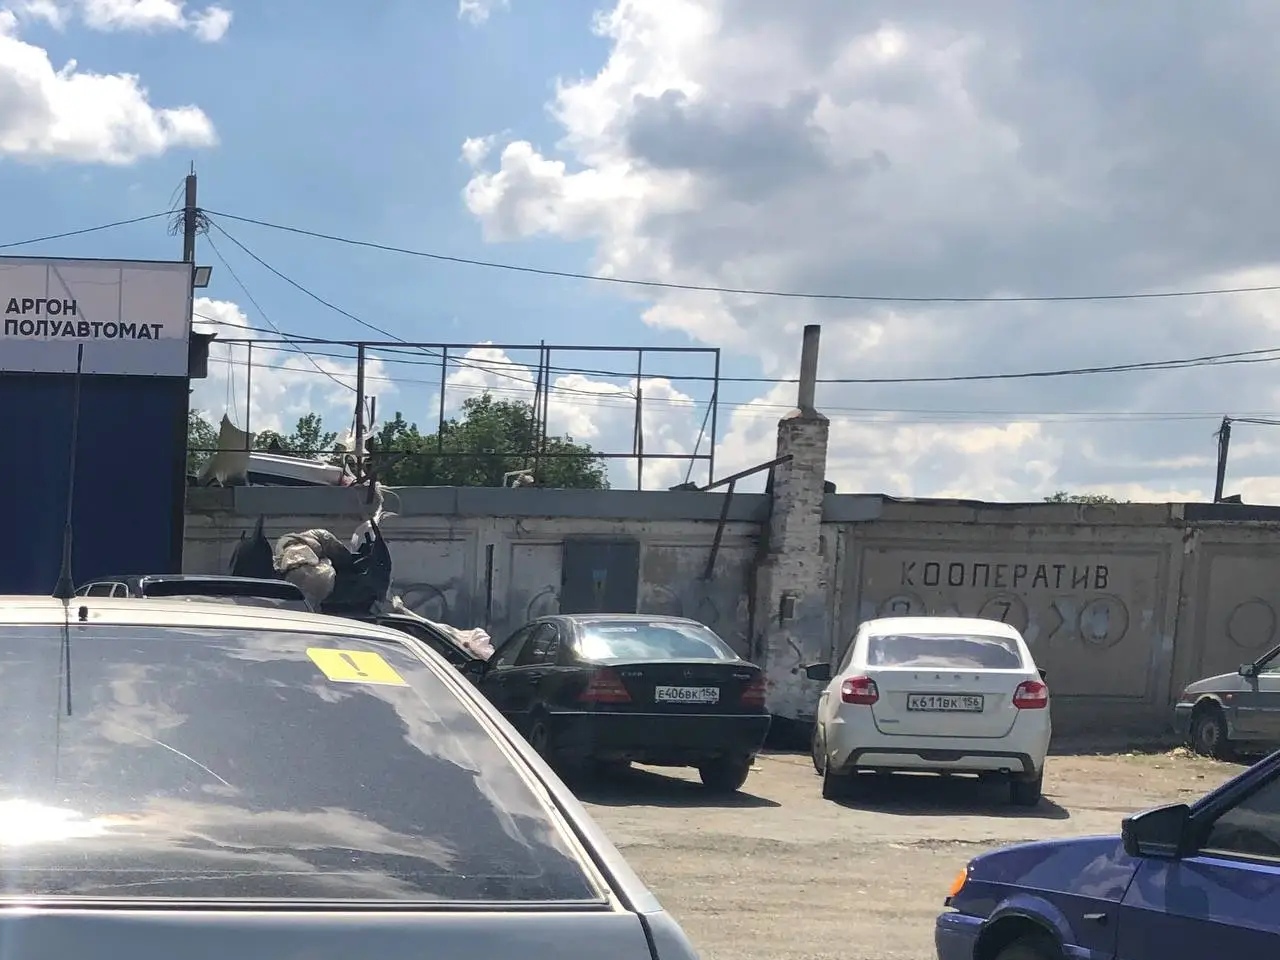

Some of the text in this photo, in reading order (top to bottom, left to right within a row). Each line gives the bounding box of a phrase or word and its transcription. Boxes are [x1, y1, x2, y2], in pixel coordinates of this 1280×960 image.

[5, 298, 77, 316] АРГОН
[4, 319, 164, 340] ПОЛУАВТОМАТ
[900, 561, 1109, 590] КООПЕРАТИВ
